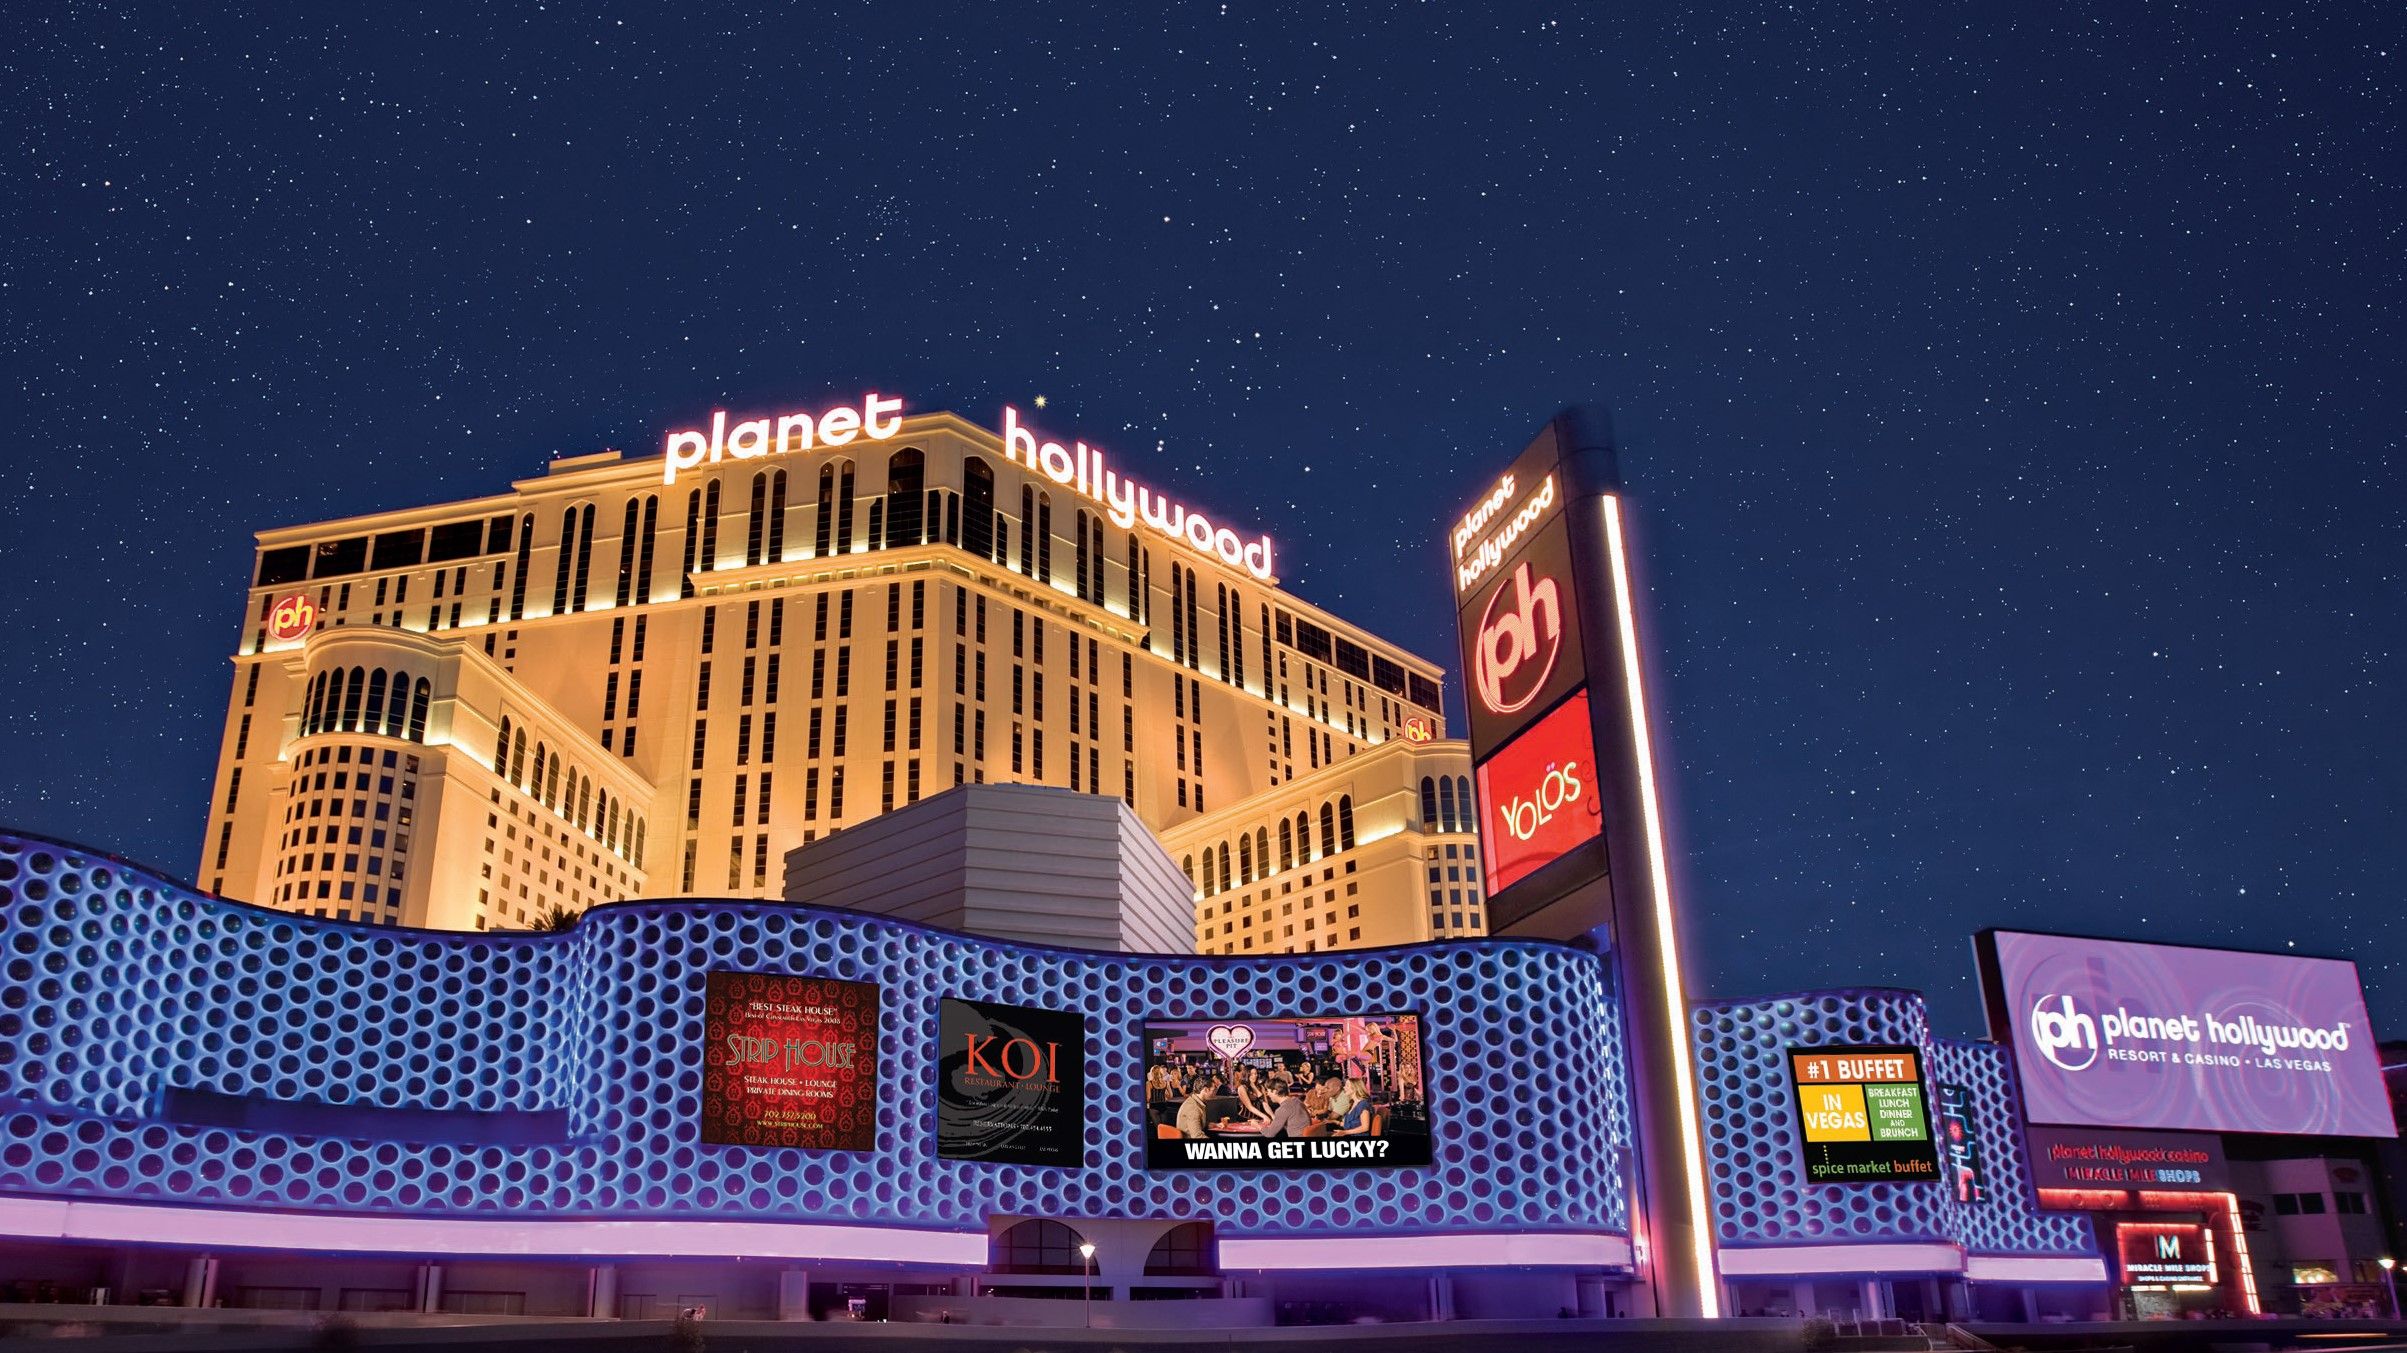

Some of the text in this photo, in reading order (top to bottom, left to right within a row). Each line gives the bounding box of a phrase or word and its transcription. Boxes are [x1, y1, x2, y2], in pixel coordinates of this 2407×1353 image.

[664, 393, 902, 485] planet
[1004, 407, 1271, 580] hollywood
[1455, 473, 1514, 558] planet
[1458, 475, 1553, 591] hollywood
[274, 596, 313, 635] ph
[1482, 562, 1560, 704] ph
[776, 1004, 802, 1014] STEAK
[2036, 995, 2097, 1063] ph
[2101, 1007, 2349, 1055] planet hollywood
[726, 1033, 856, 1073] STRIP HOUSE
[964, 1033, 1062, 1083] KOI
[2108, 1049, 2332, 1072] RESORT & CASINO LAS VEGAS
[1807, 1059, 1904, 1079] #1 BUFFET
[744, 1075, 837, 1088] STEAK HOUSE LOUNGE
[964, 1077, 1020, 1089] RESTAURANT
[747, 1086, 834, 1098] PRIVATE DINING ROOMS
[1823, 1094, 1842, 1110] IN
[1868, 1088, 1917, 1097] BREAKFAST
[1879, 1099, 1910, 1108] LUNCH
[1806, 1112, 1866, 1129] VEGAS
[1879, 1110, 1913, 1119] DINNER
[1880, 1128, 1918, 1138] BRUNCH
[1185, 1140, 1390, 1160] WANNA GET LUCKY?
[2050, 1144, 2209, 1164] planet hollywood casino
[1812, 1160, 1932, 1177] spice market buffet
[2157, 1169, 2201, 1183] SHOPS
[2158, 1235, 2180, 1259] M
